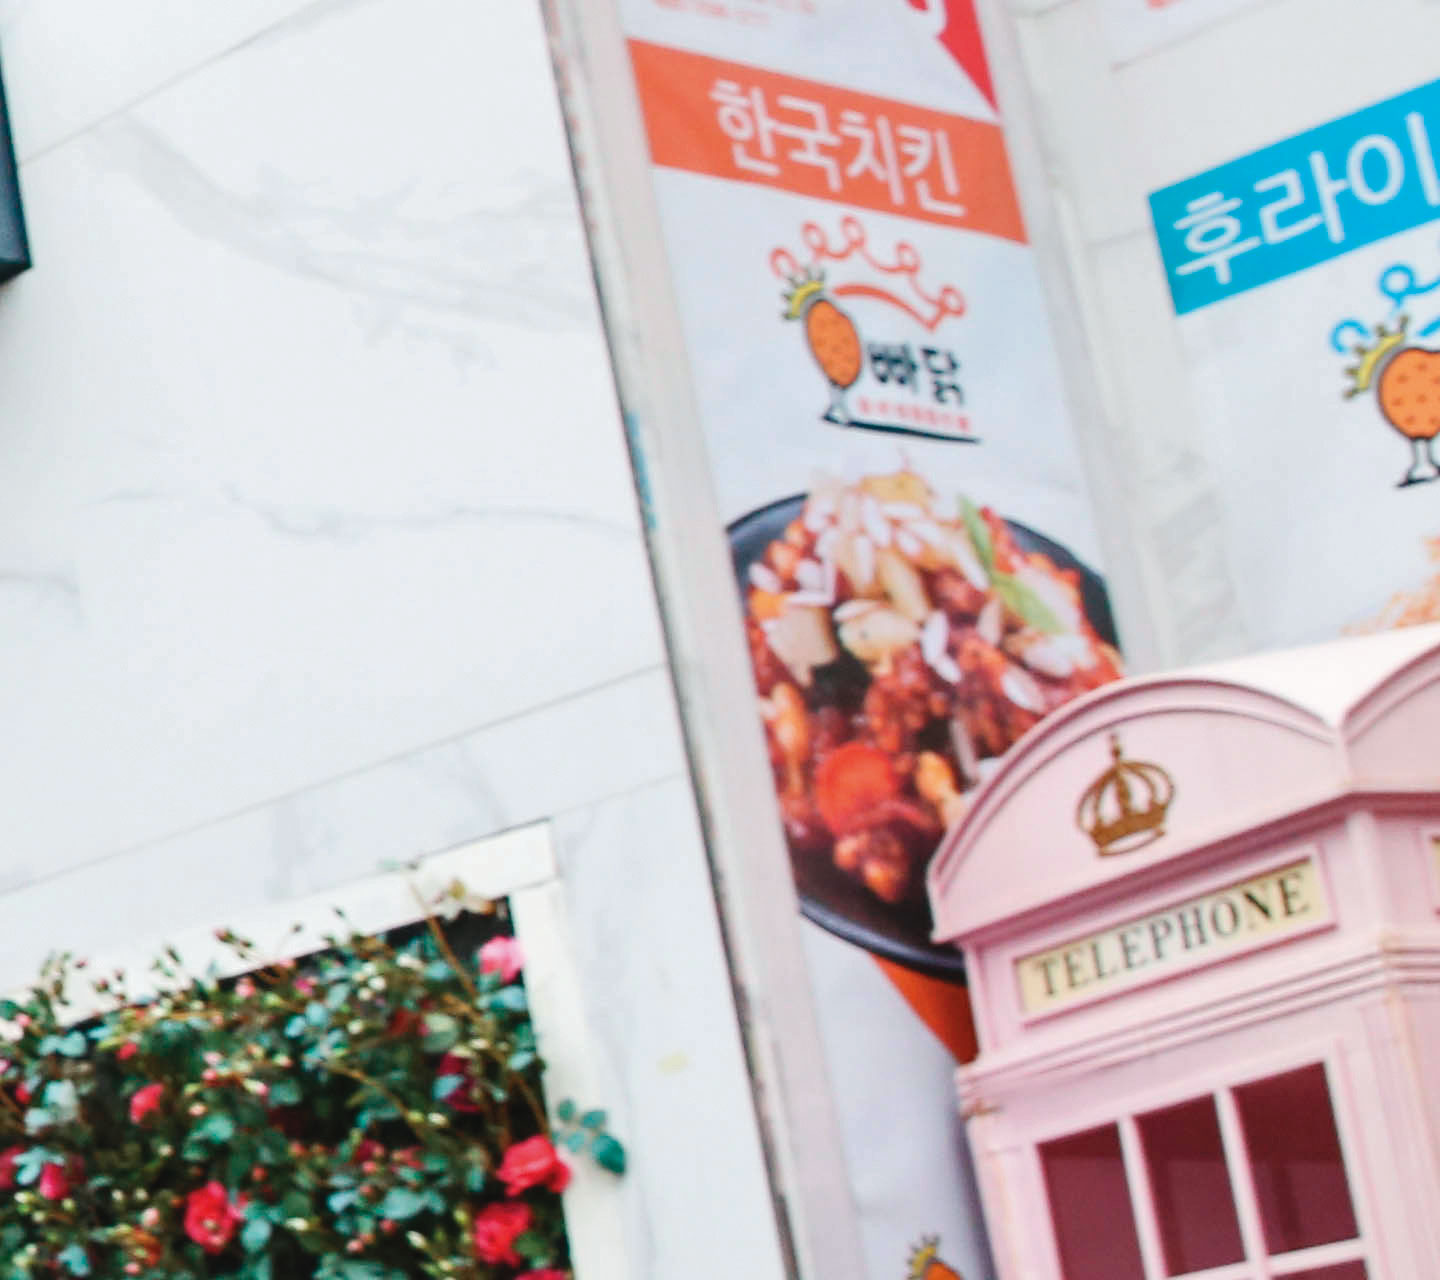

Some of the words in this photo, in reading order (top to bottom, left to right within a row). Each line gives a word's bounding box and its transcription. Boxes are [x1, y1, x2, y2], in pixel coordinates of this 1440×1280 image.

[709, 79, 966, 218] 한국치킨
[1174, 112, 1440, 284] 후라이
[1036, 870, 1313, 996] TELEPHONE
